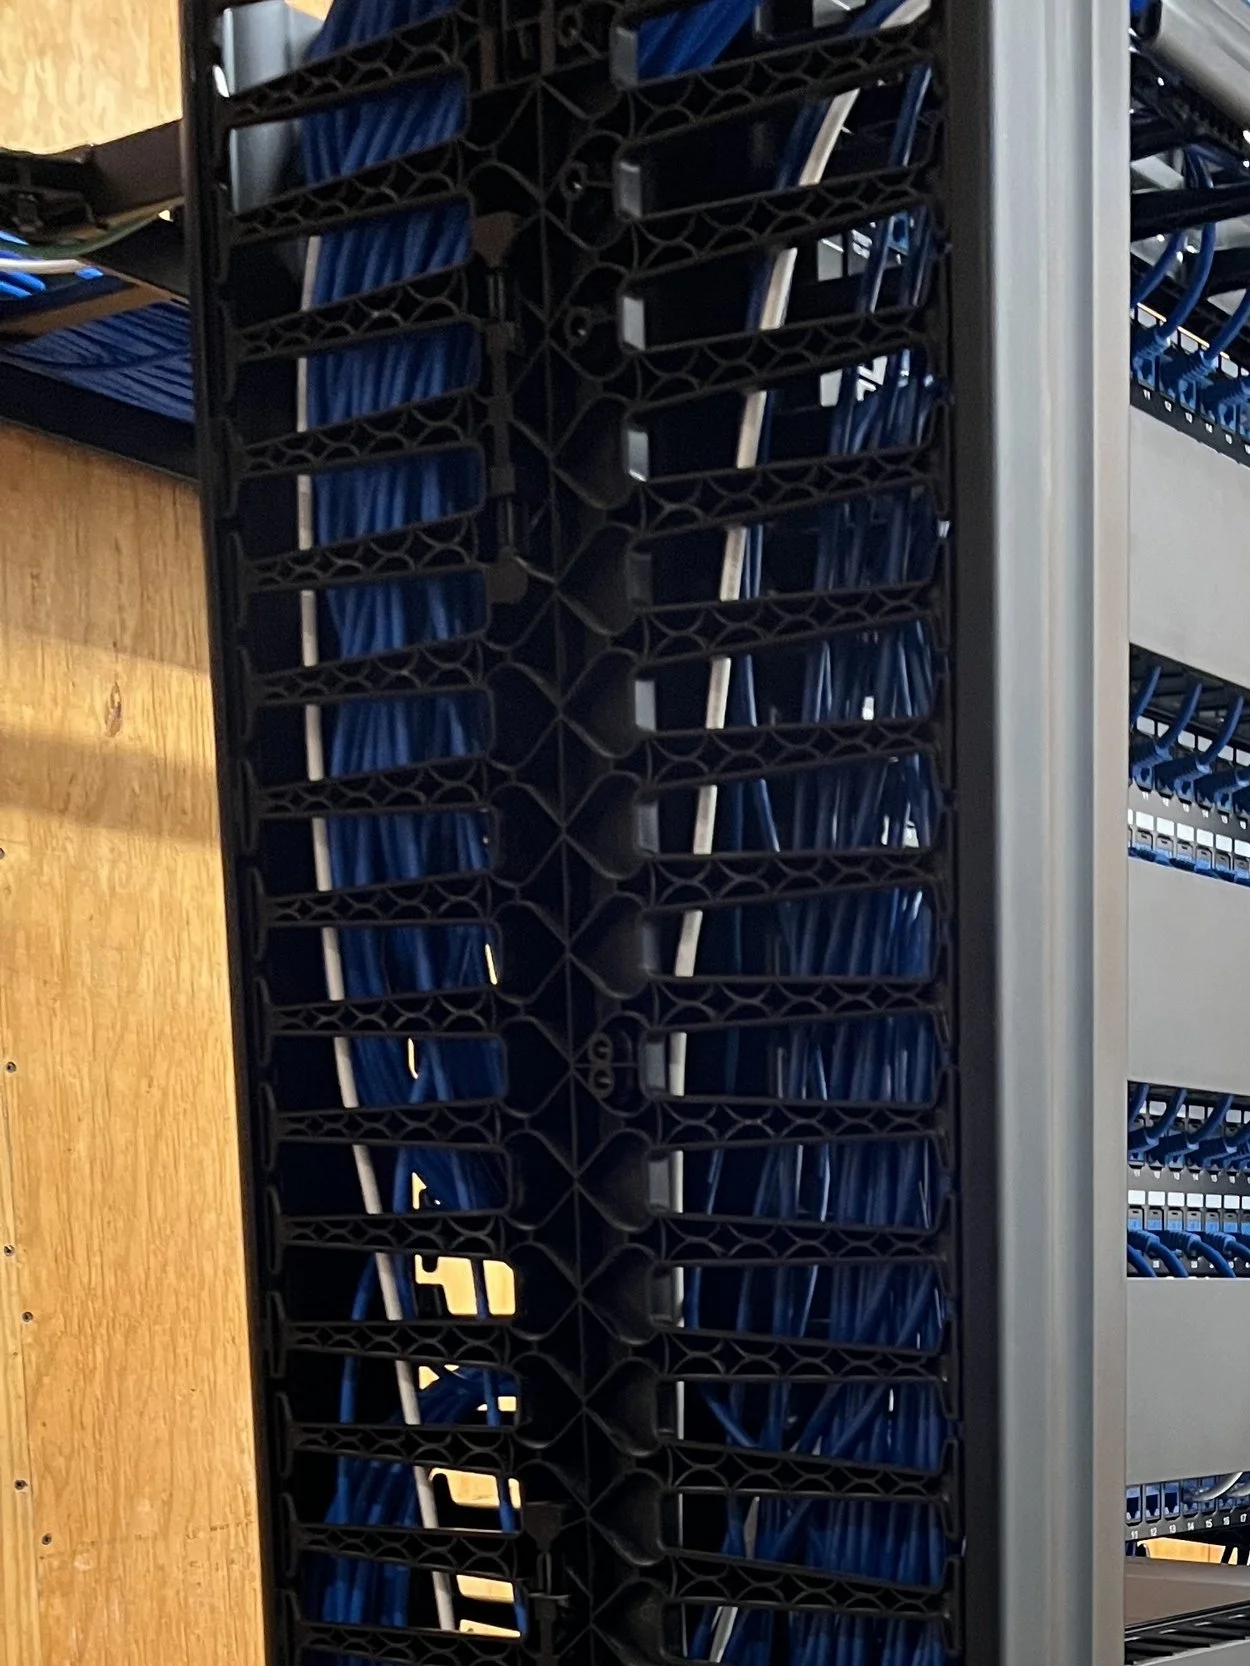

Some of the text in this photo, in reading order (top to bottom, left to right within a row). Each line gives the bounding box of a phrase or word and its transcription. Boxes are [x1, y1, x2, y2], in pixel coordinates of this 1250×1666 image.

[1131, 1530, 1139, 1538] 11
[1150, 1527, 1158, 1536] 12
[1169, 1524, 1177, 1533] 13
[1187, 1522, 1195, 1530] 14
[1206, 1519, 1213, 1528] 15
[1223, 1516, 1230, 1525] 16
[1240, 1513, 1247, 1522] 17
